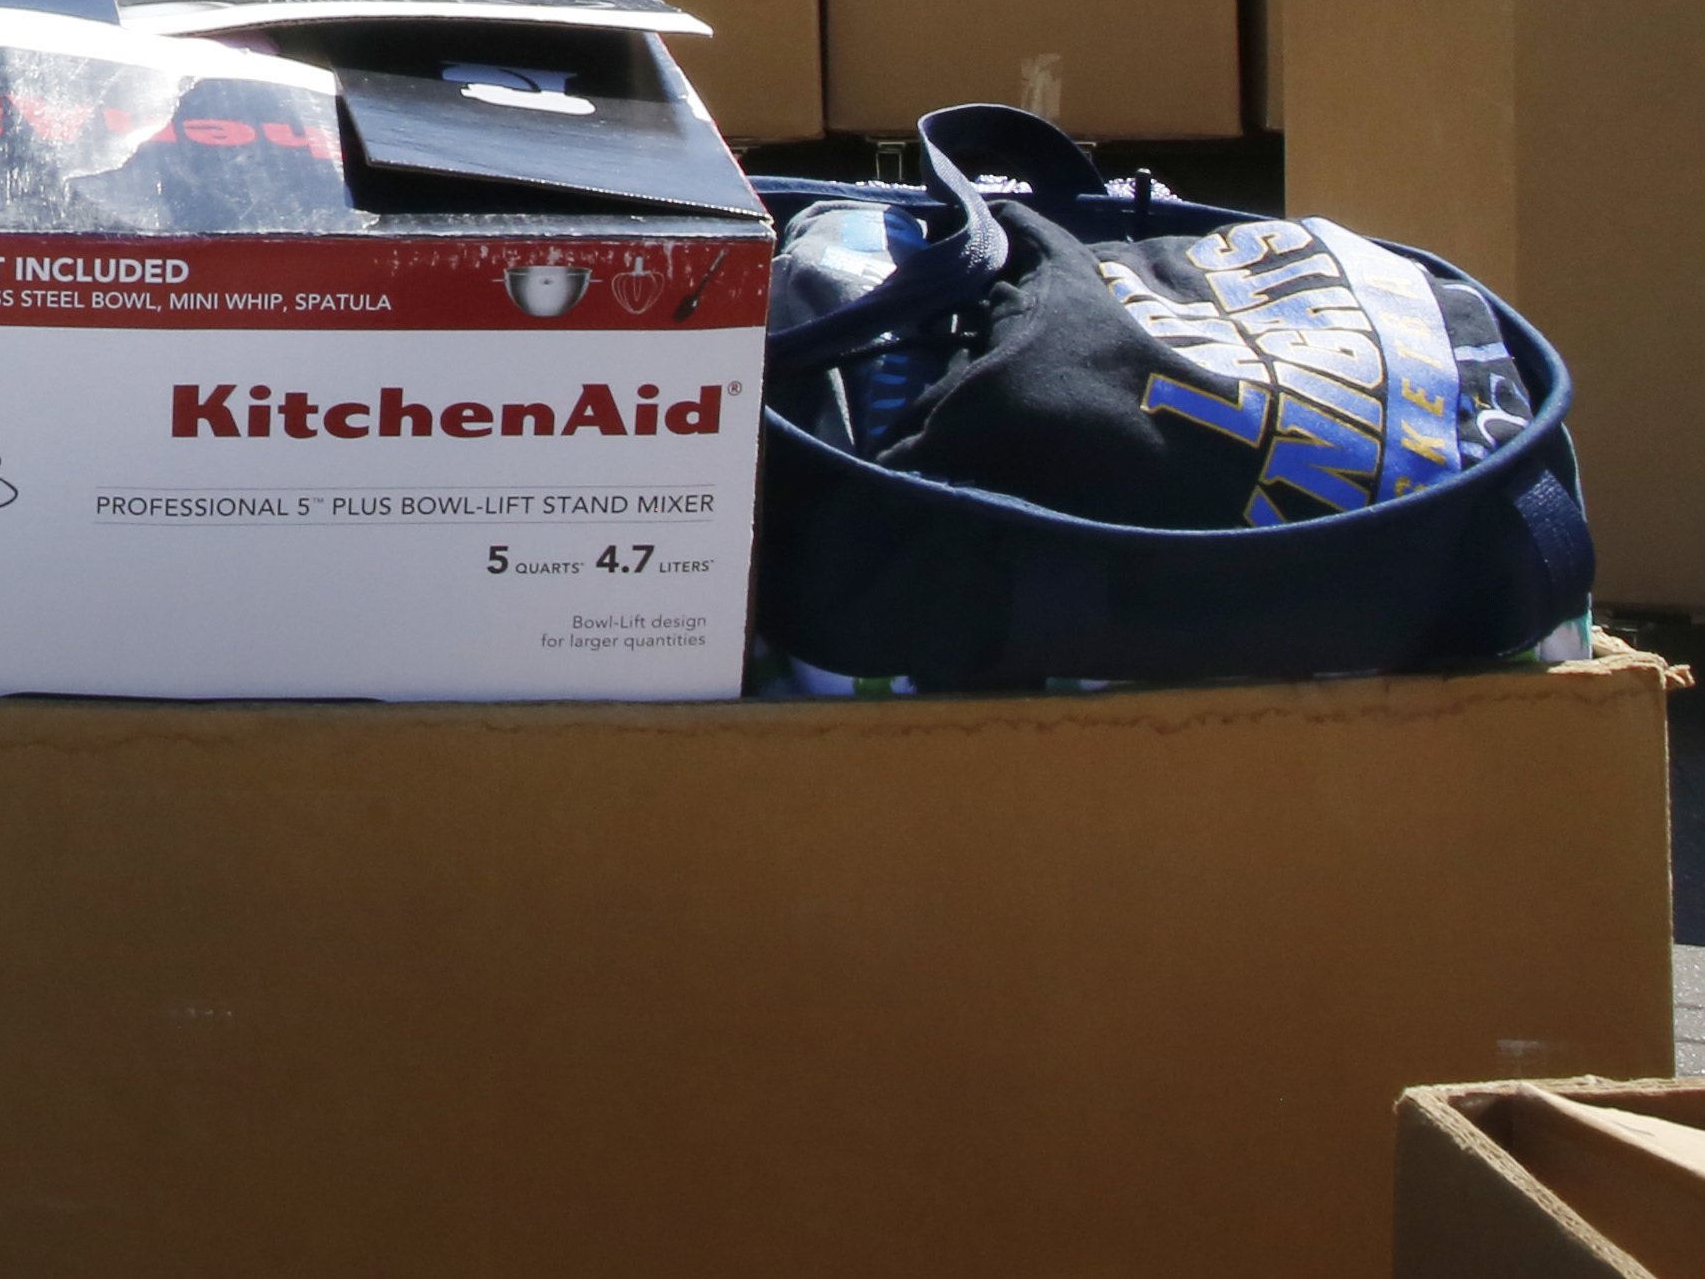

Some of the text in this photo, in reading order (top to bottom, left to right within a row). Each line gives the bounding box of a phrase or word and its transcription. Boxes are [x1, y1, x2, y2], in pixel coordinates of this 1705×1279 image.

[15, 256, 190, 284] INCLUDED
[20, 289, 85, 309] STEEL
[91, 291, 163, 313] BOWL,
[169, 292, 219, 311] MINI
[224, 292, 288, 314] WHIP,
[294, 293, 393, 312] SPATULA
[96, 496, 289, 517] PROFESSIONAL
[332, 497, 391, 516] PLUS
[401, 496, 535, 515] BOWL-LIFT
[543, 495, 628, 515] STAND
[637, 494, 715, 513] MIXER
[486, 545, 509, 575] 5
[595, 544, 656, 574] 4.7
[572, 614, 707, 631] Bowl-Lift design
[541, 634, 706, 652] for larger quantities
